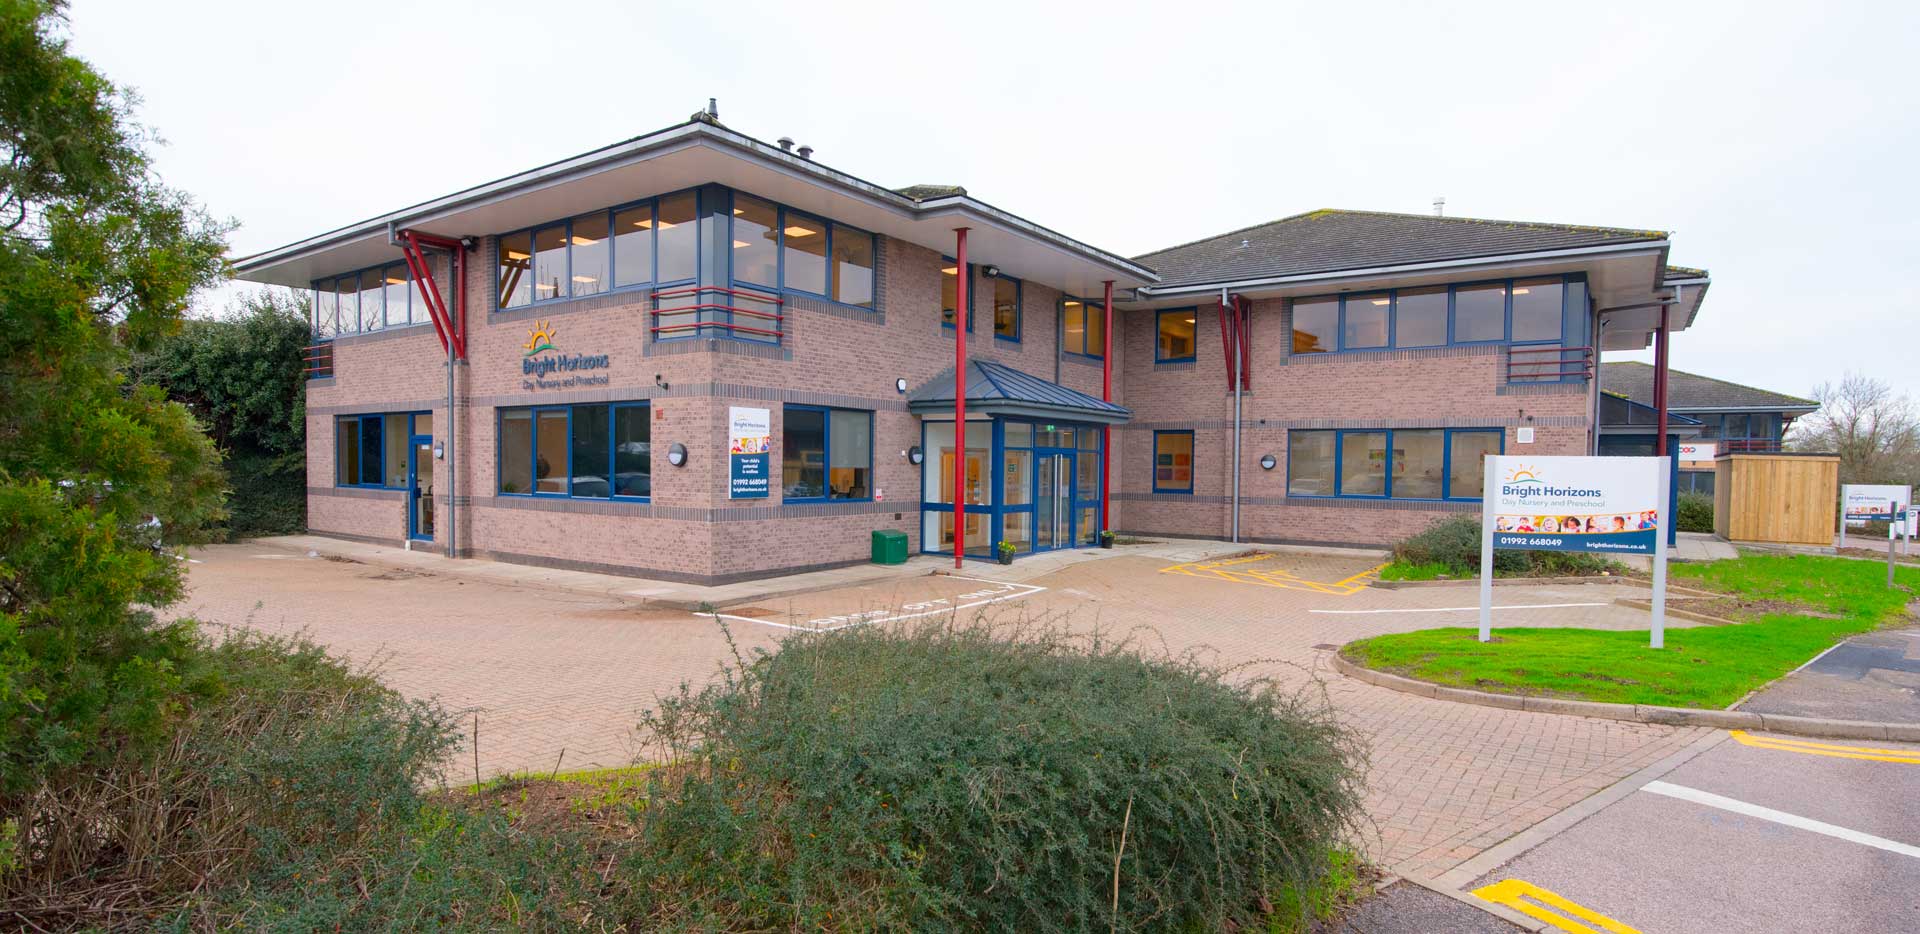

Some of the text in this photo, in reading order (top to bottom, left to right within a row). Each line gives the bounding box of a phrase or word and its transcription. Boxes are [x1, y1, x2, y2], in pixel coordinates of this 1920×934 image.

[523, 354, 609, 378] Bright Horizons
[523, 380, 535, 392] Day
[562, 376, 575, 387] and
[733, 478, 767, 486] 01992 668049
[1503, 485, 1602, 499] Bright Horizons
[1502, 498, 1606, 508] Day Nursery and Preschool
[1500, 536, 1562, 547] 01992 668049
[1586, 542, 1647, 550] brighthorizons.co.uk
[903, 599, 949, 610] OFF
[958, 585, 1014, 598] ONLY
